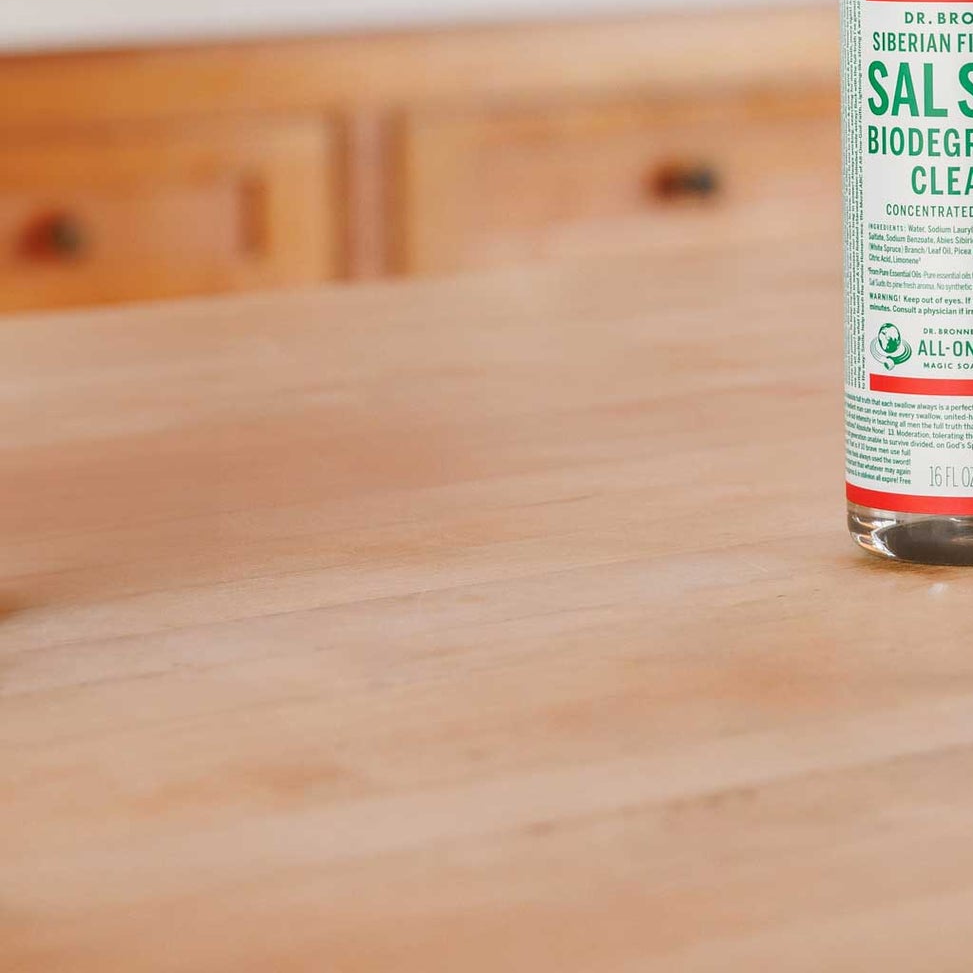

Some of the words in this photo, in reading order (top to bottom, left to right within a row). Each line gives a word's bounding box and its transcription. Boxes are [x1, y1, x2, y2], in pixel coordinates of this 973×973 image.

[905, 12, 932, 24] DR.
[873, 32, 950, 53] SIBERIAN
[868, 61, 948, 117] SAL
[868, 223, 906, 231] INGREDIENTS:
[953, 227, 973, 235] Lauryl
[884, 244, 904, 254] Spruce)
[946, 282, 972, 292] synthetic
[870, 292, 901, 302] WARNING!
[904, 296, 919, 304] Keep
[944, 297, 963, 305] eyes.
[893, 305, 916, 313] Consult
[924, 307, 957, 316] physician
[929, 466, 942, 487] 16
[945, 466, 958, 487] FL
